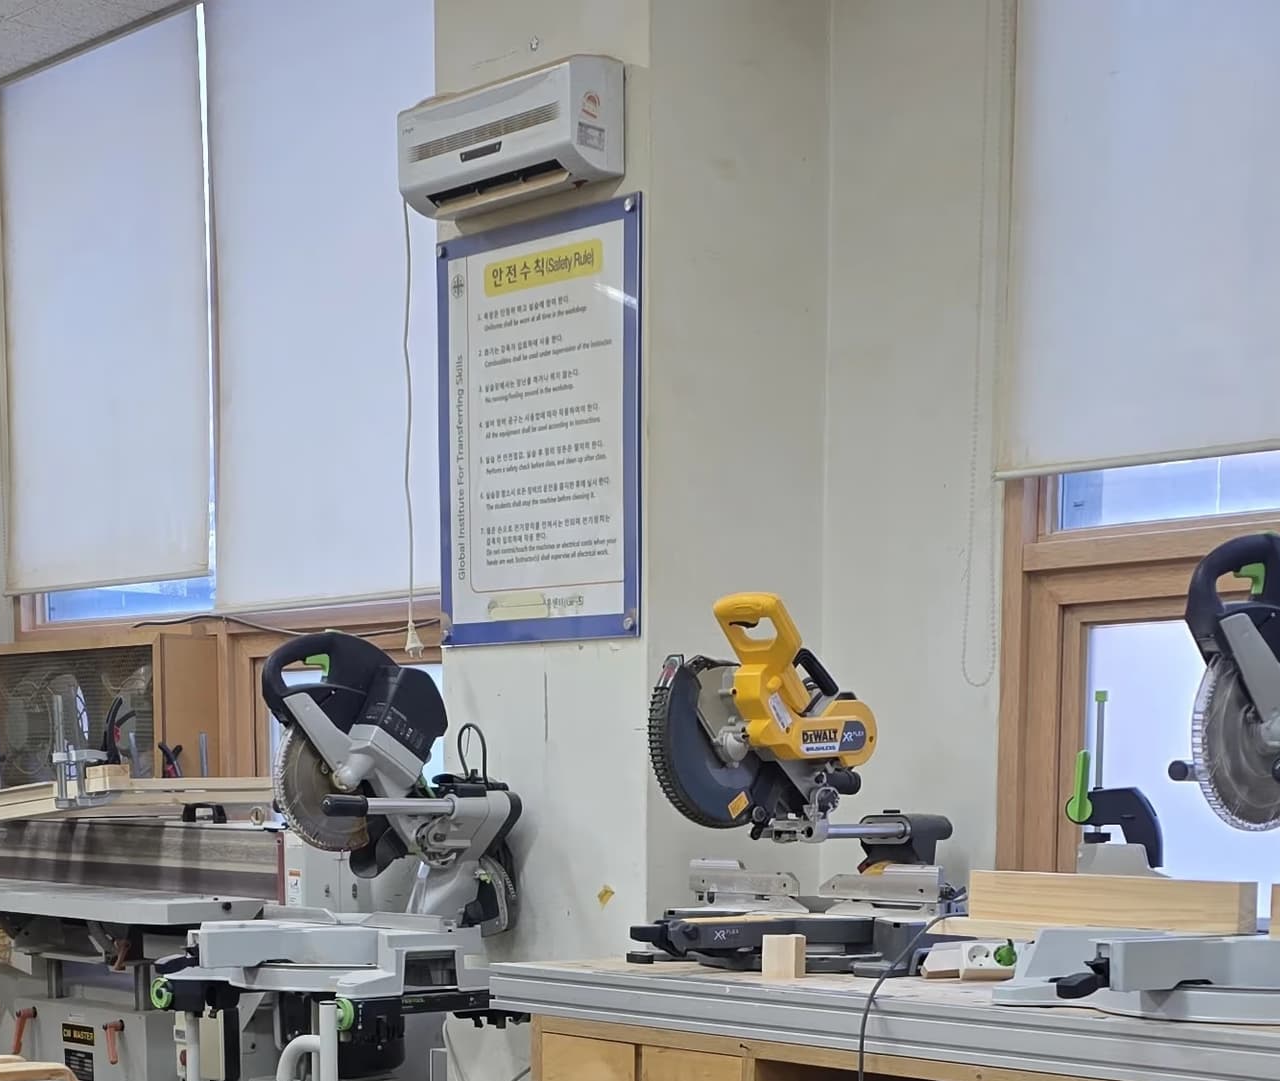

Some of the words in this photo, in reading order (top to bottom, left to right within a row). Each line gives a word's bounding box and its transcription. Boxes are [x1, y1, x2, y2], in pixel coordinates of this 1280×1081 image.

[574, 247, 594, 268] Rule)
[455, 354, 464, 386] Skills
[455, 388, 465, 464] Transferring
[456, 465, 465, 485] For
[456, 488, 465, 539] Institute
[457, 543, 466, 581] Global
